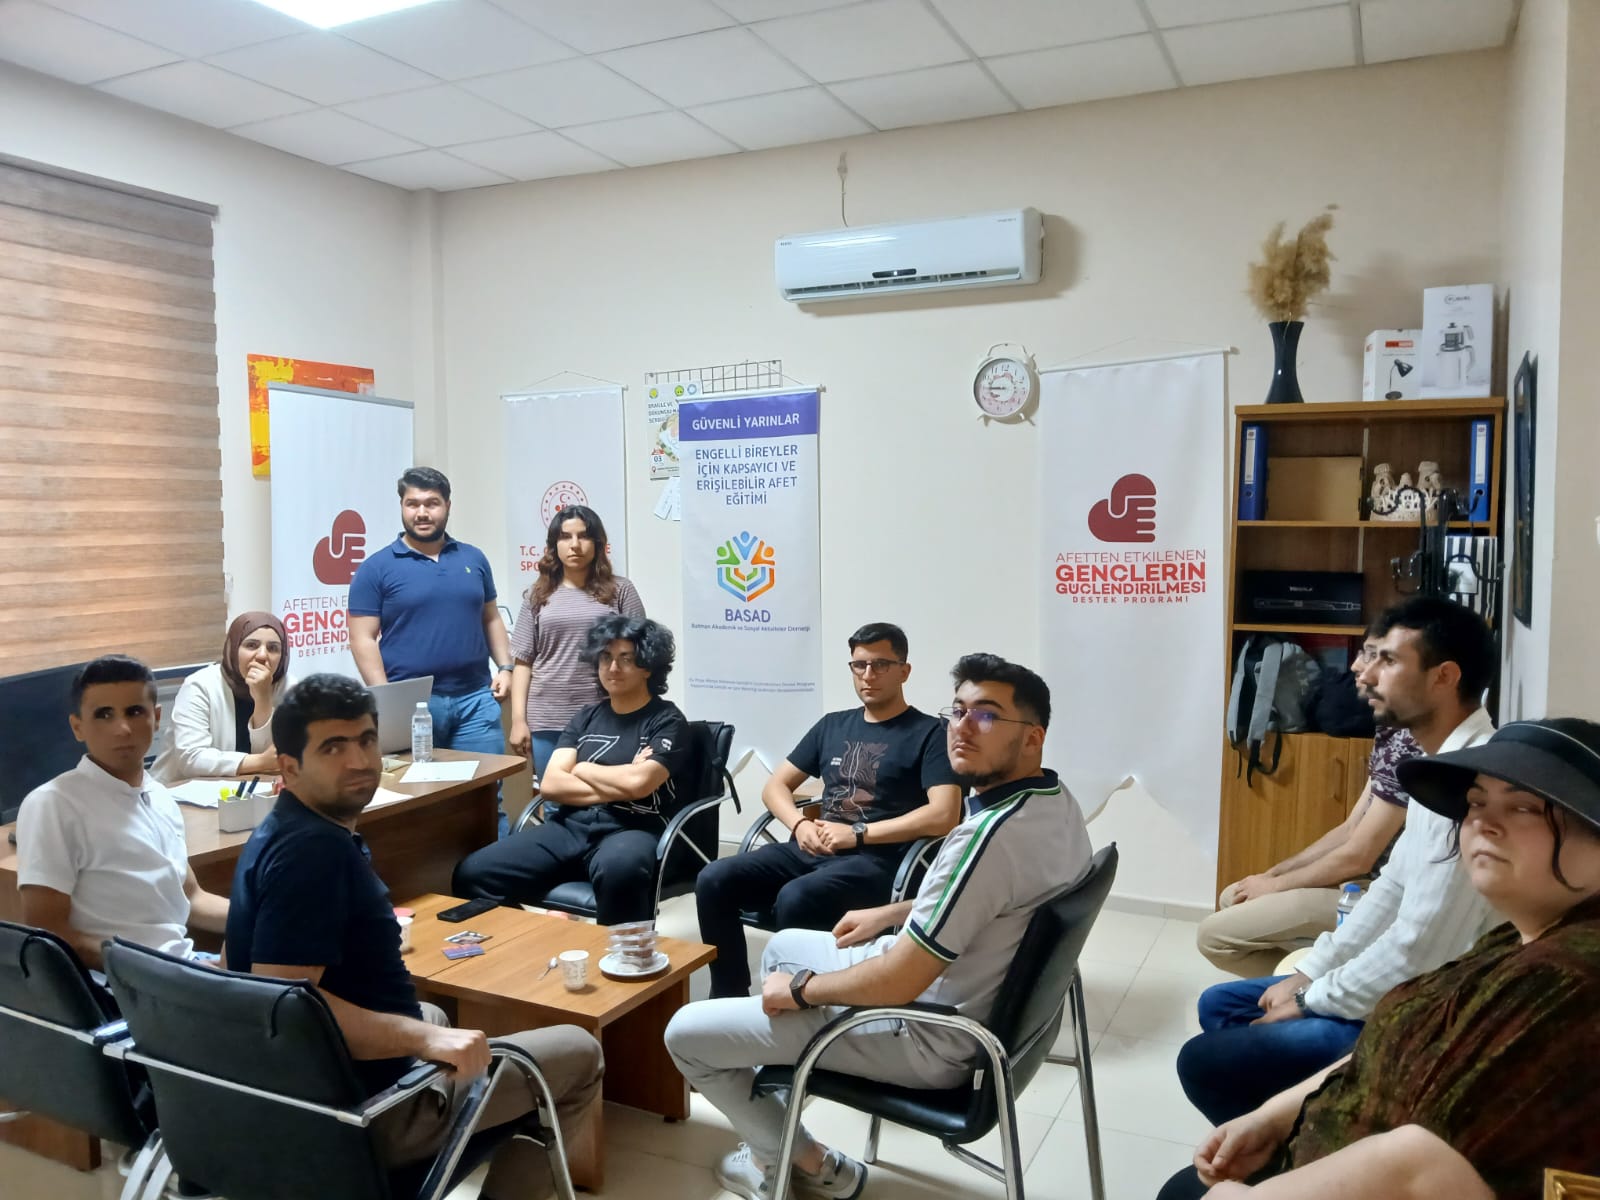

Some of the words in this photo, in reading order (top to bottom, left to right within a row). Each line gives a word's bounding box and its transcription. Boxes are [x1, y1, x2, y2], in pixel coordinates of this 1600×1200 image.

[692, 415, 741, 431] GÜVENLİ
[744, 413, 800, 428] YARINLAR
[695, 445, 741, 460] ENGELLİ
[745, 444, 798, 458] BİREYLER
[697, 462, 720, 477] İÇİN
[724, 462, 778, 474] KAPSAYICI
[781, 460, 796, 472] VE
[696, 476, 765, 493] ERİŞİLEBİLİR
[768, 476, 798, 488] AFET
[726, 491, 767, 505] EĞİTİMİ
[520, 545, 540, 557] T.C.
[1055, 552, 1119, 563] AFETTEN
[520, 560, 540, 572] SPO
[1055, 562, 1206, 582] GENÇLERİN
[283, 596, 338, 611] AFETTEN
[1072, 596, 1117, 604] DESTEK
[1123, 595, 1189, 604] PROGRAMI
[725, 608, 771, 623] BASAD
[298, 646, 336, 658] DESTEK
